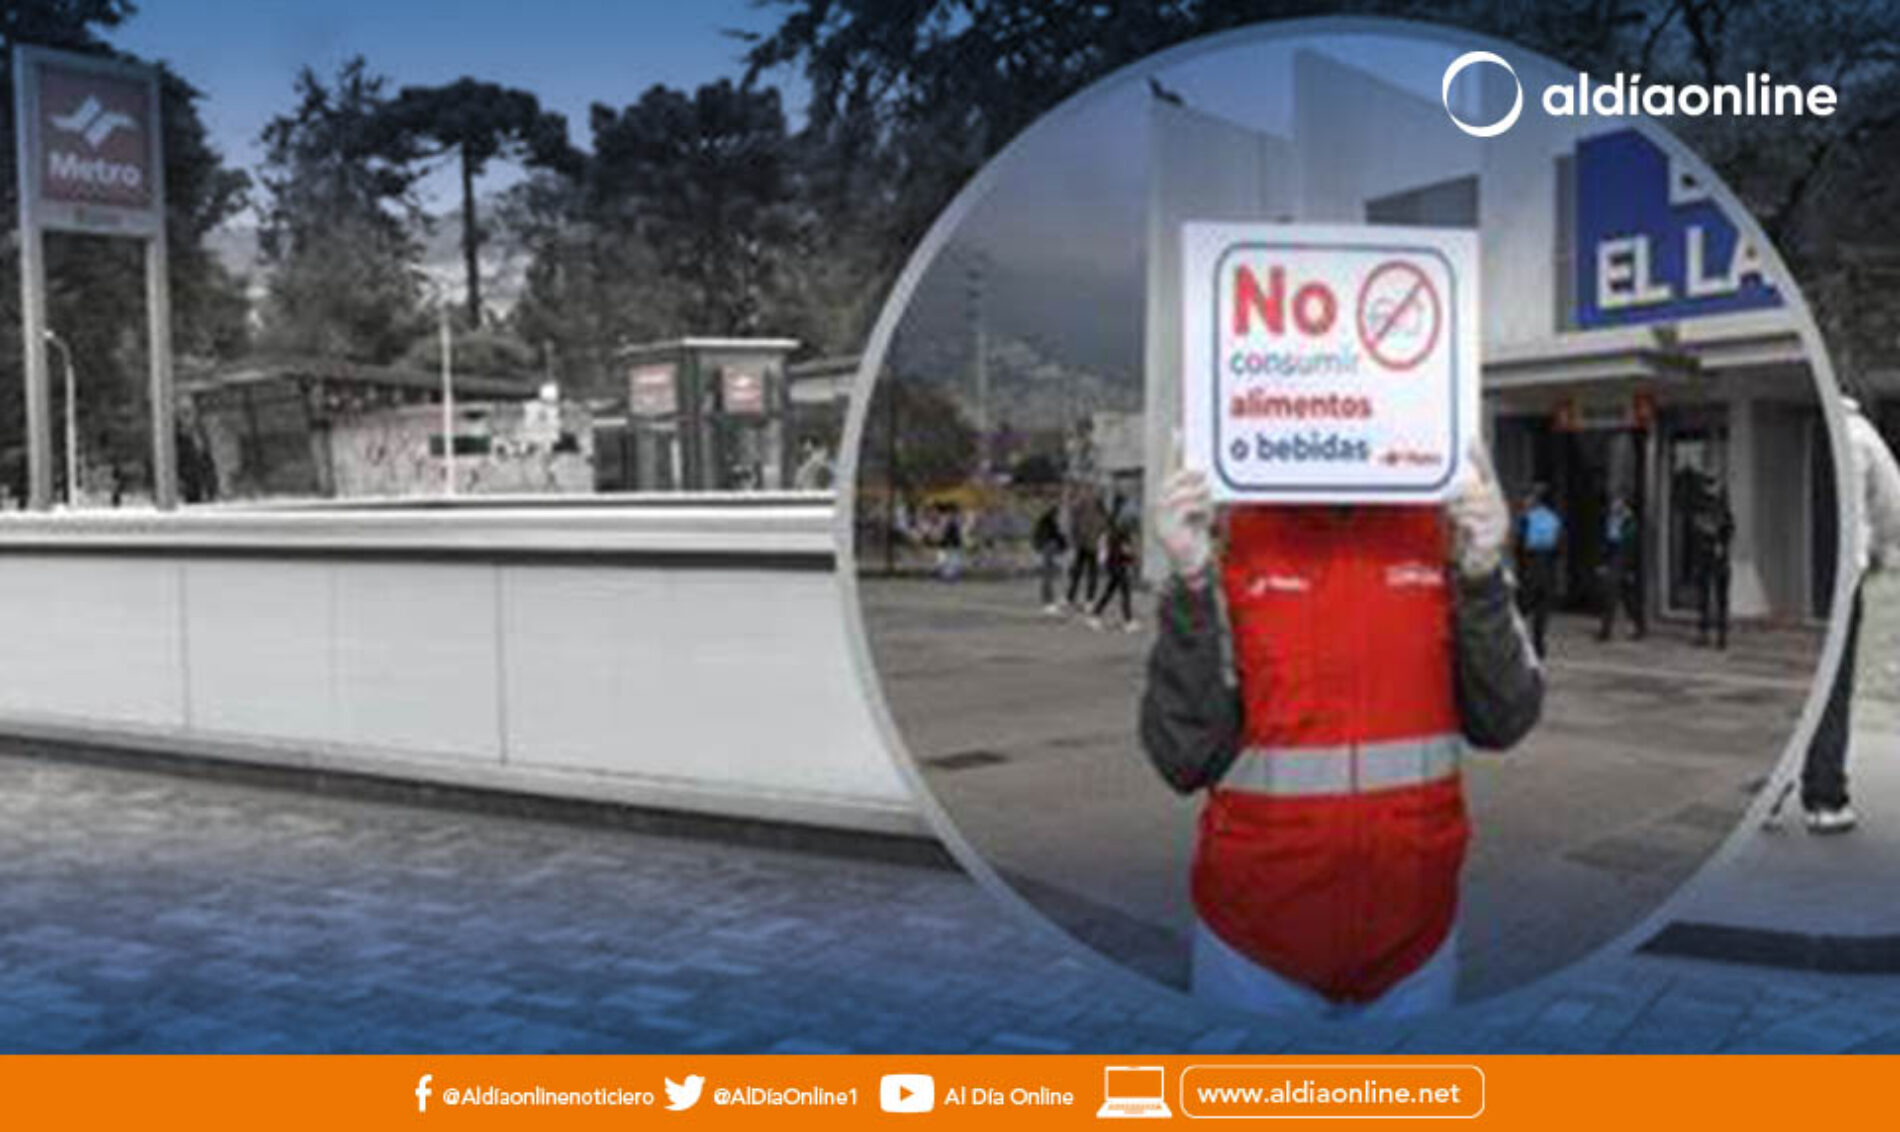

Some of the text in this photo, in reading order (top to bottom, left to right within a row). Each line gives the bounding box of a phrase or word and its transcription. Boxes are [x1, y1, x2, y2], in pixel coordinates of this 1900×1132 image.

[48, 151, 143, 188] Metro
[1597, 235, 1672, 309] EL
[1231, 264, 1338, 337] No
[1229, 350, 1359, 377] consumir
[1229, 386, 1373, 419] alimentos
[1229, 430, 1370, 463] o bebidas
